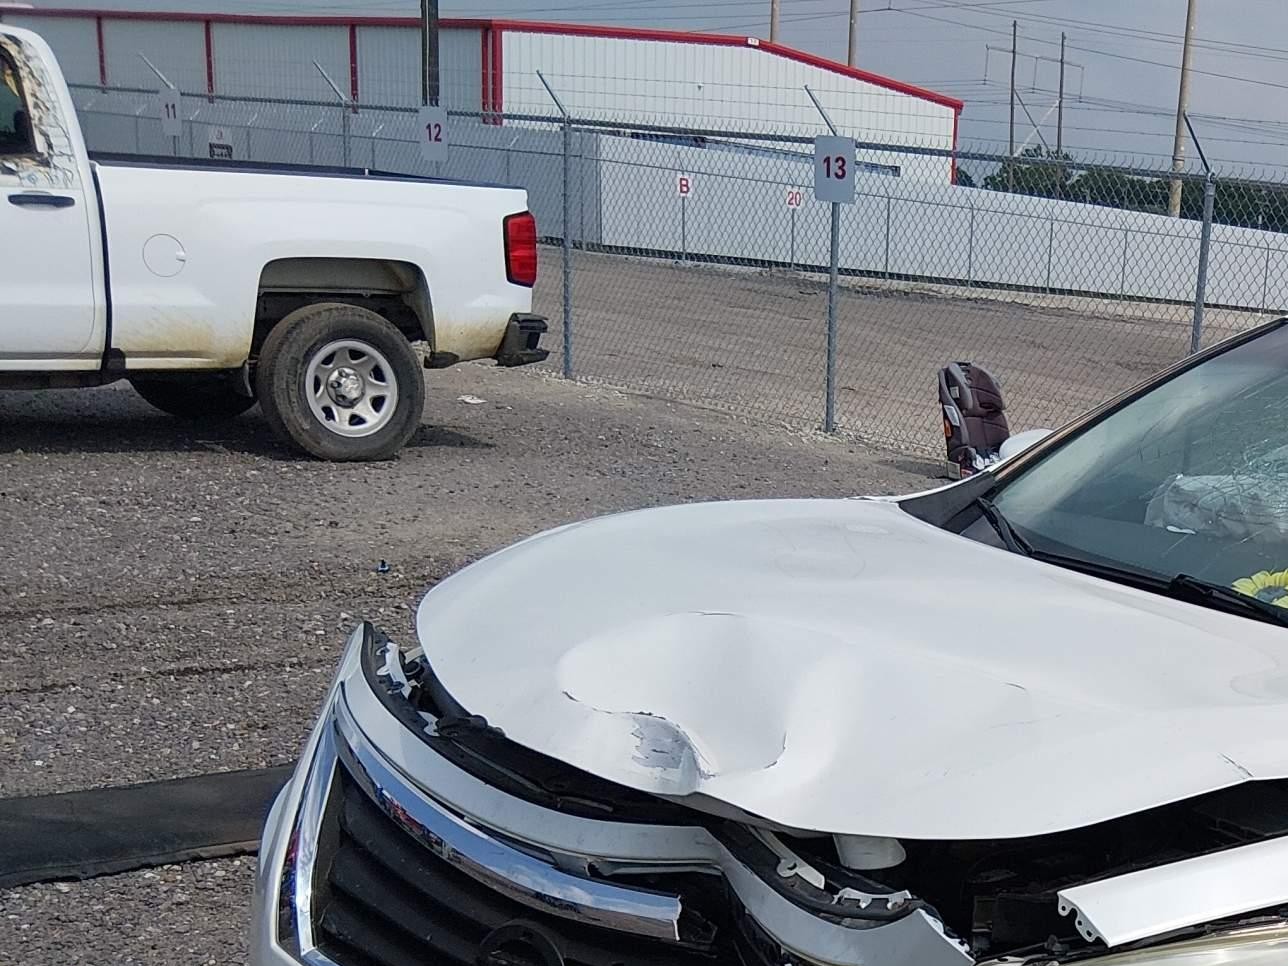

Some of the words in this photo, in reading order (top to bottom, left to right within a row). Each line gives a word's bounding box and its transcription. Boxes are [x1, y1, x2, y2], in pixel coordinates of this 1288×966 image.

[165, 102, 176, 119] 11
[426, 123, 442, 142] 12
[823, 156, 847, 180] 13
[679, 177, 690, 194] B
[787, 190, 801, 207] 20
